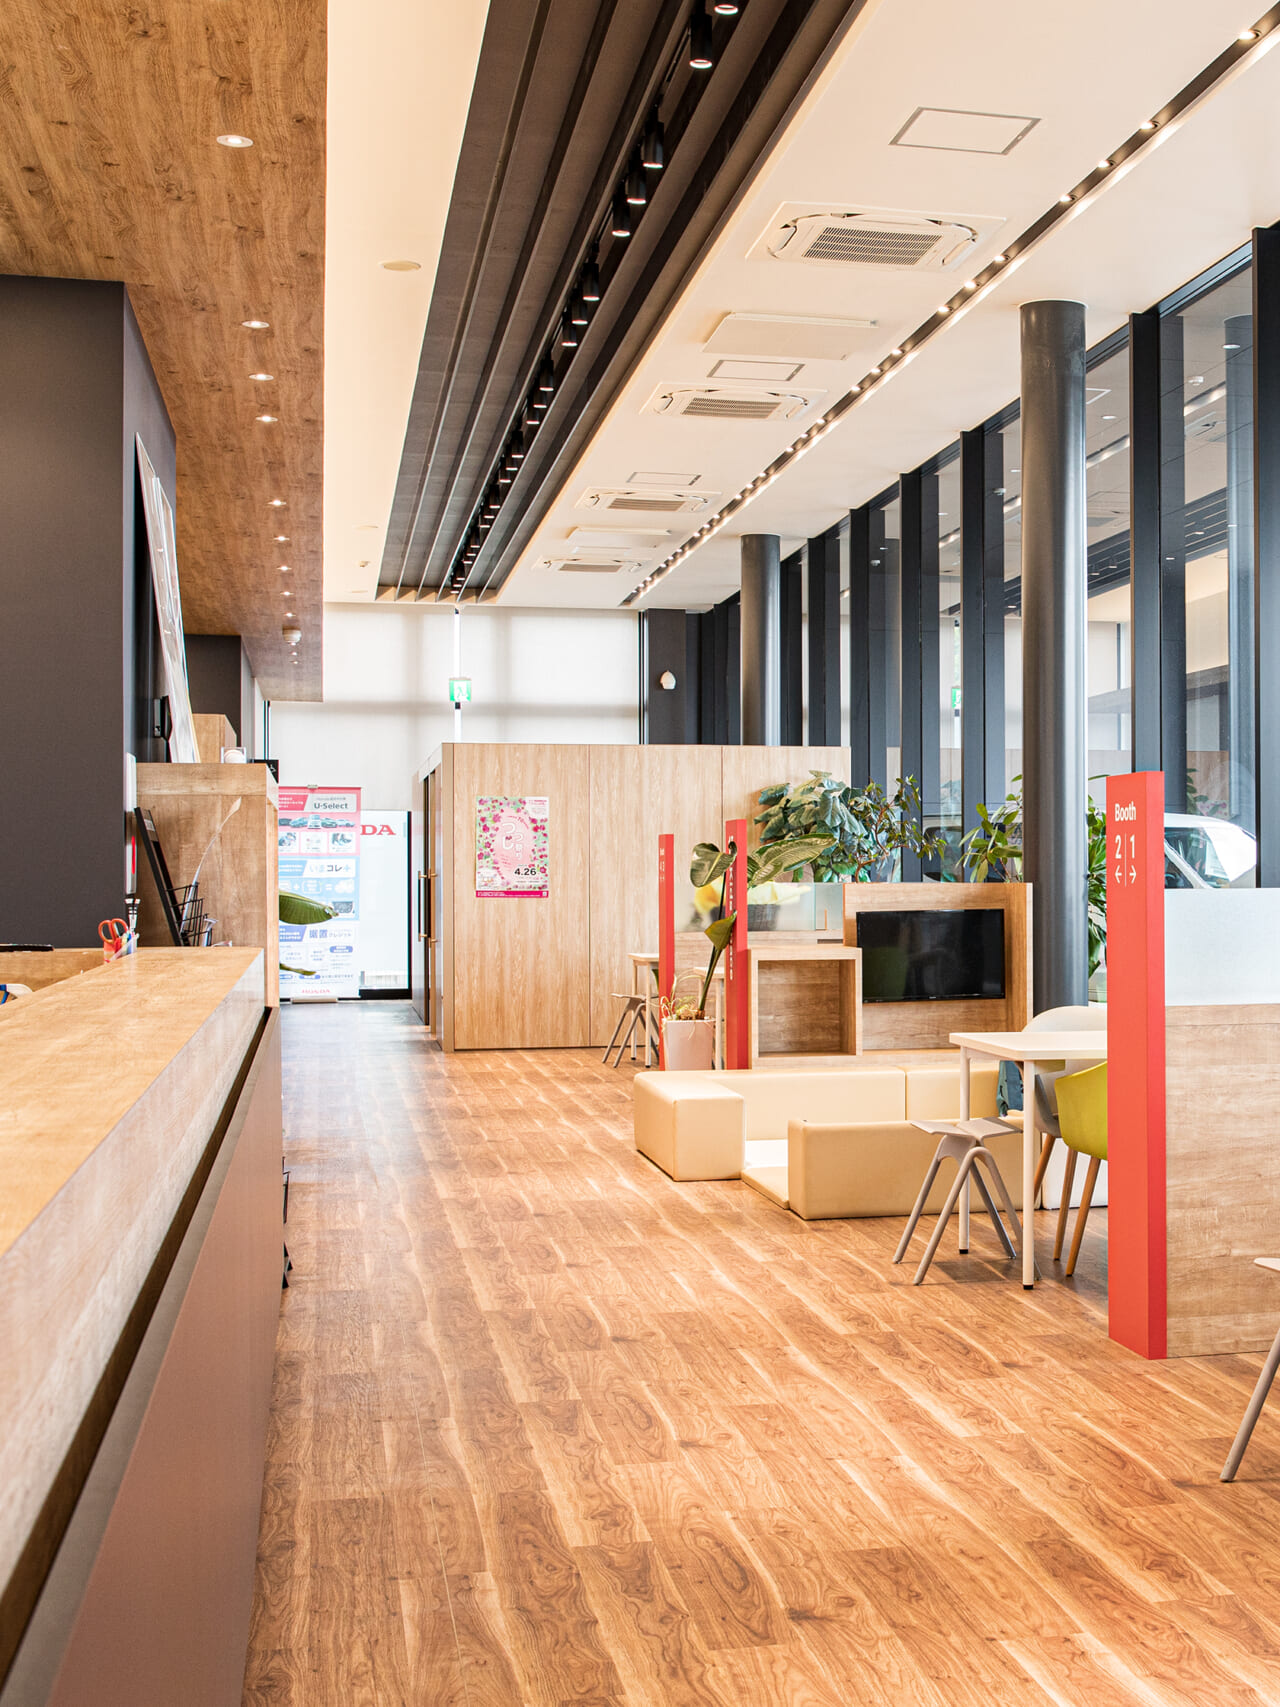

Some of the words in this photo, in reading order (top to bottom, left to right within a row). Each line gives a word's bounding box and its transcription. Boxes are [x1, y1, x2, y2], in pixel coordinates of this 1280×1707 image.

[1114, 801, 1137, 822] Booth
[1115, 834, 1122, 859] 2
[1129, 834, 1136, 859] 1
[514, 867, 537, 876] 4.26
